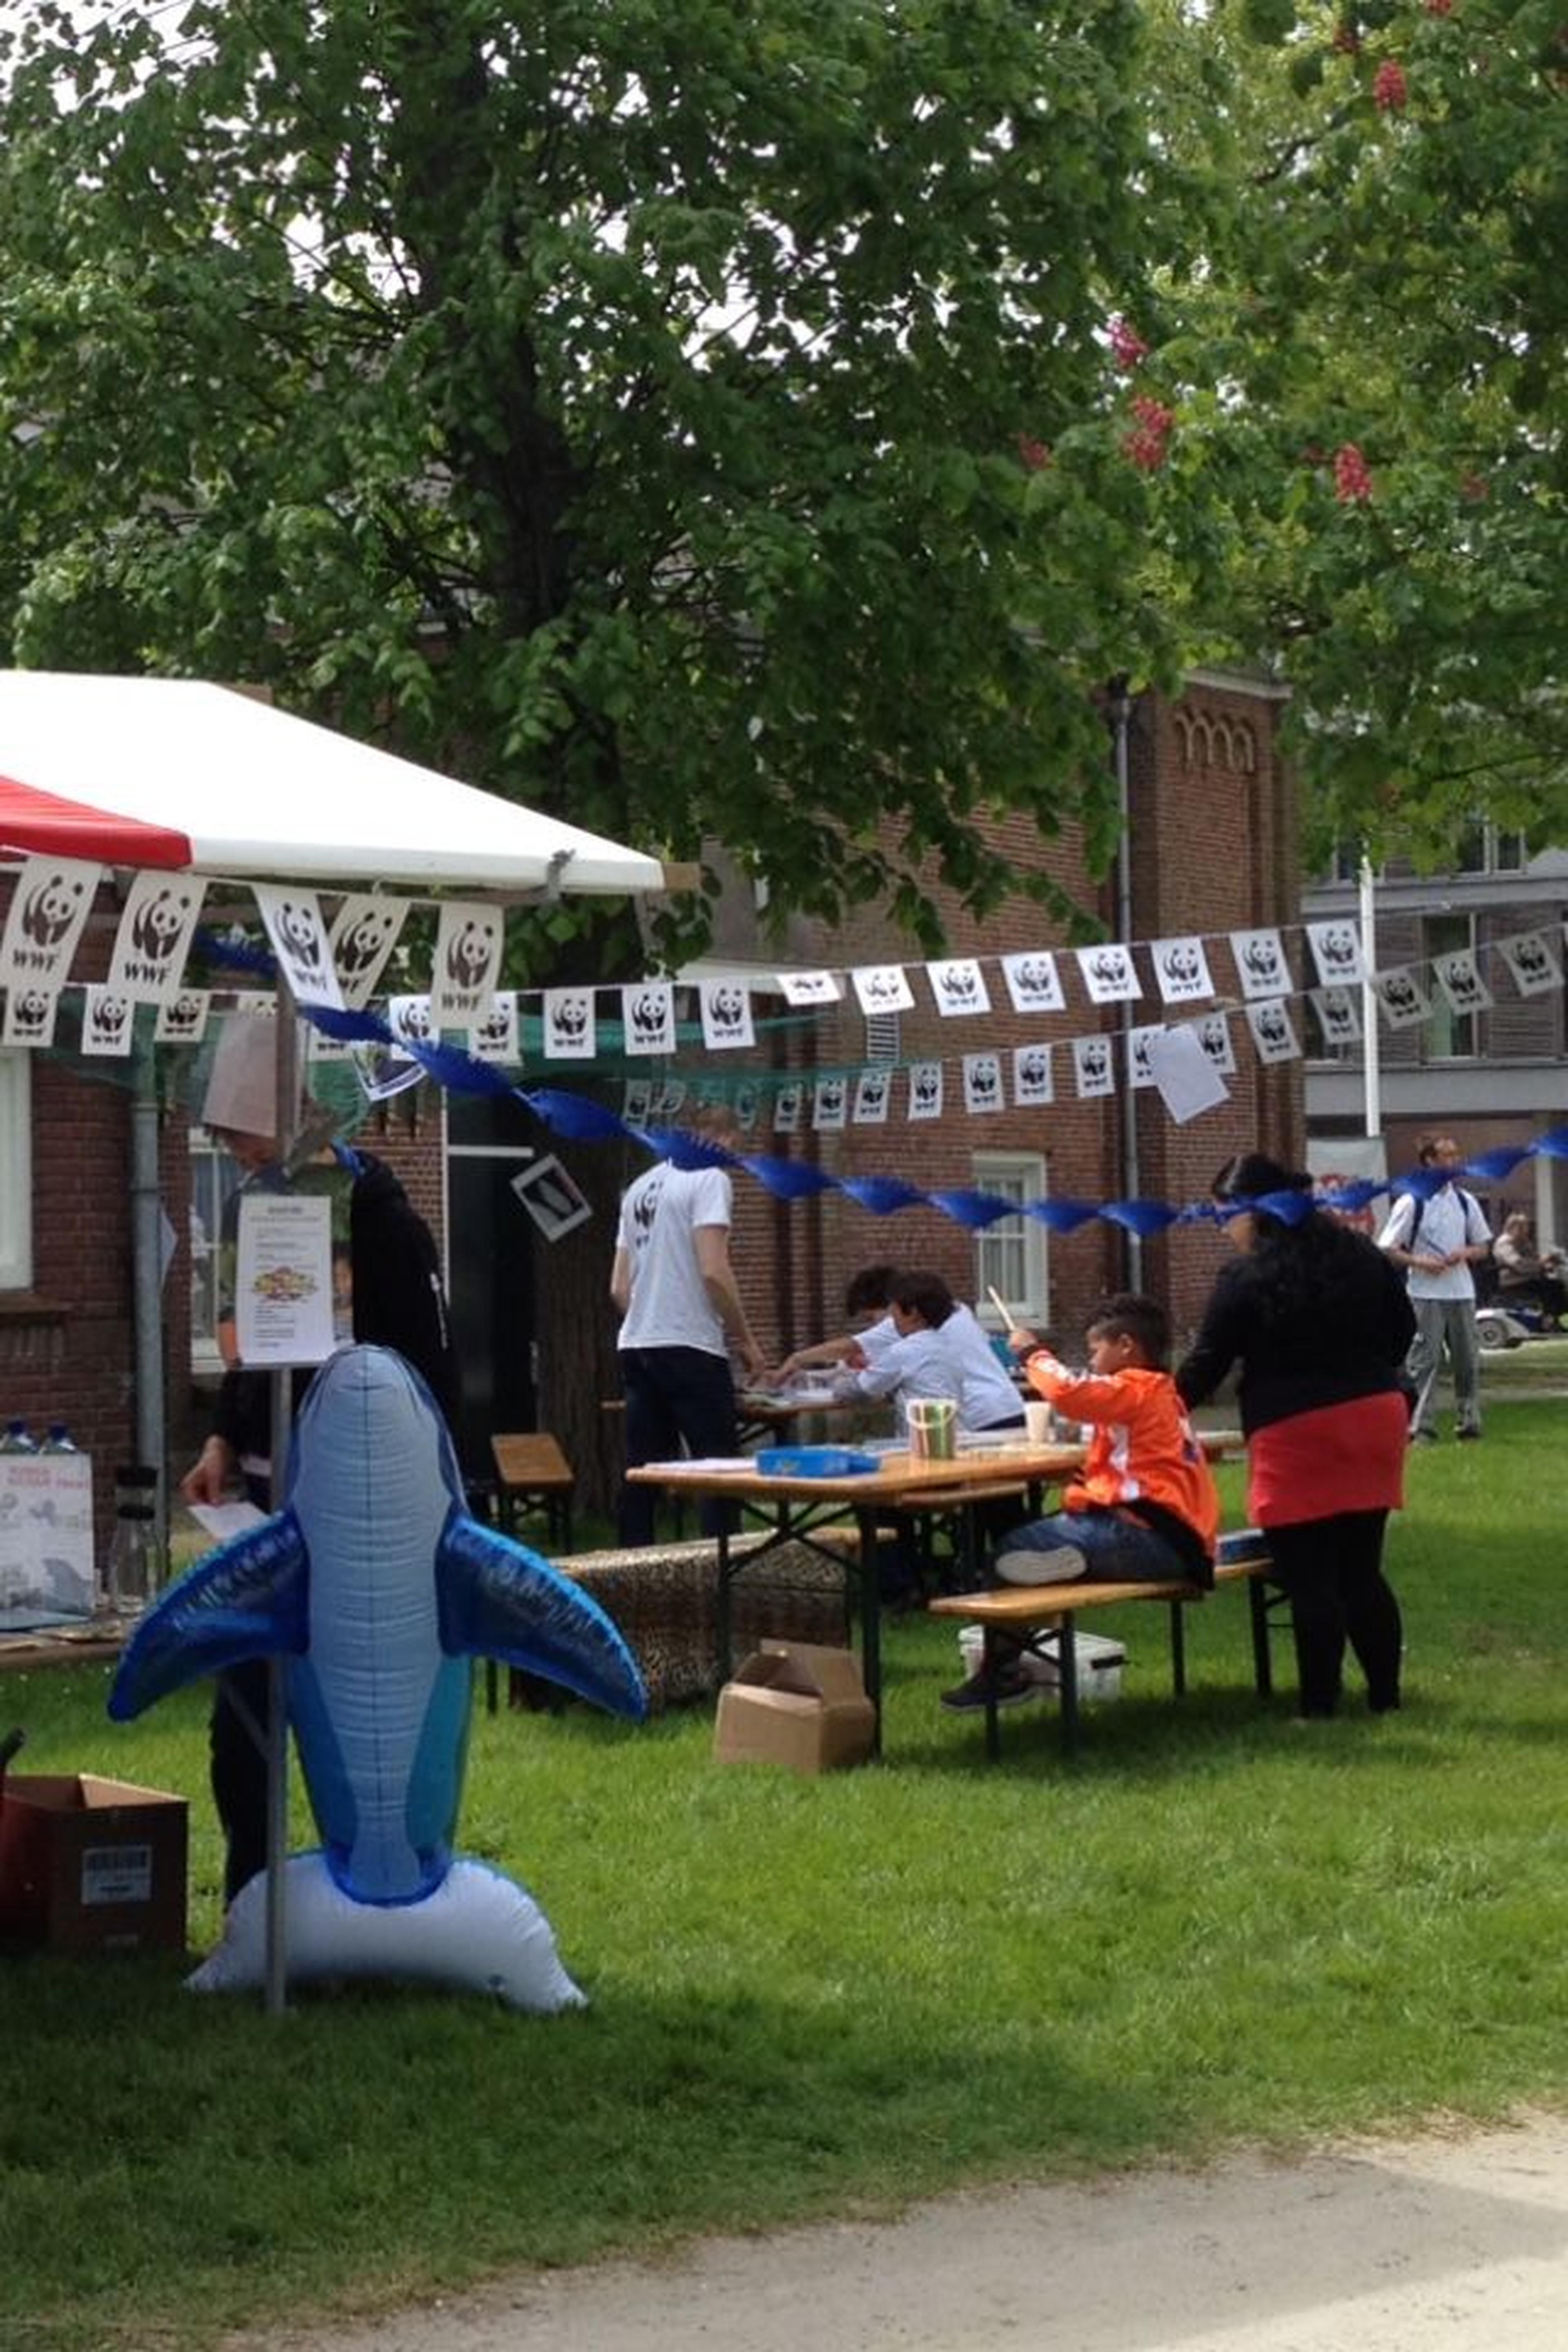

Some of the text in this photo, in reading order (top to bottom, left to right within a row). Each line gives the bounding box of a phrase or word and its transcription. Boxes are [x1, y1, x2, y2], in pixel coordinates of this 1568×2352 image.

[13, 950, 58, 972] WWF
[124, 961, 170, 985] WWF
[1171, 982, 1202, 992] WWF
[443, 993, 481, 1011] WWF
[947, 997, 978, 1006] WWF
[713, 1028, 745, 1038] WWF
[92, 1035, 122, 1045] WWF
[553, 1039, 584, 1047] WWF
[635, 1034, 666, 1044] WWF
